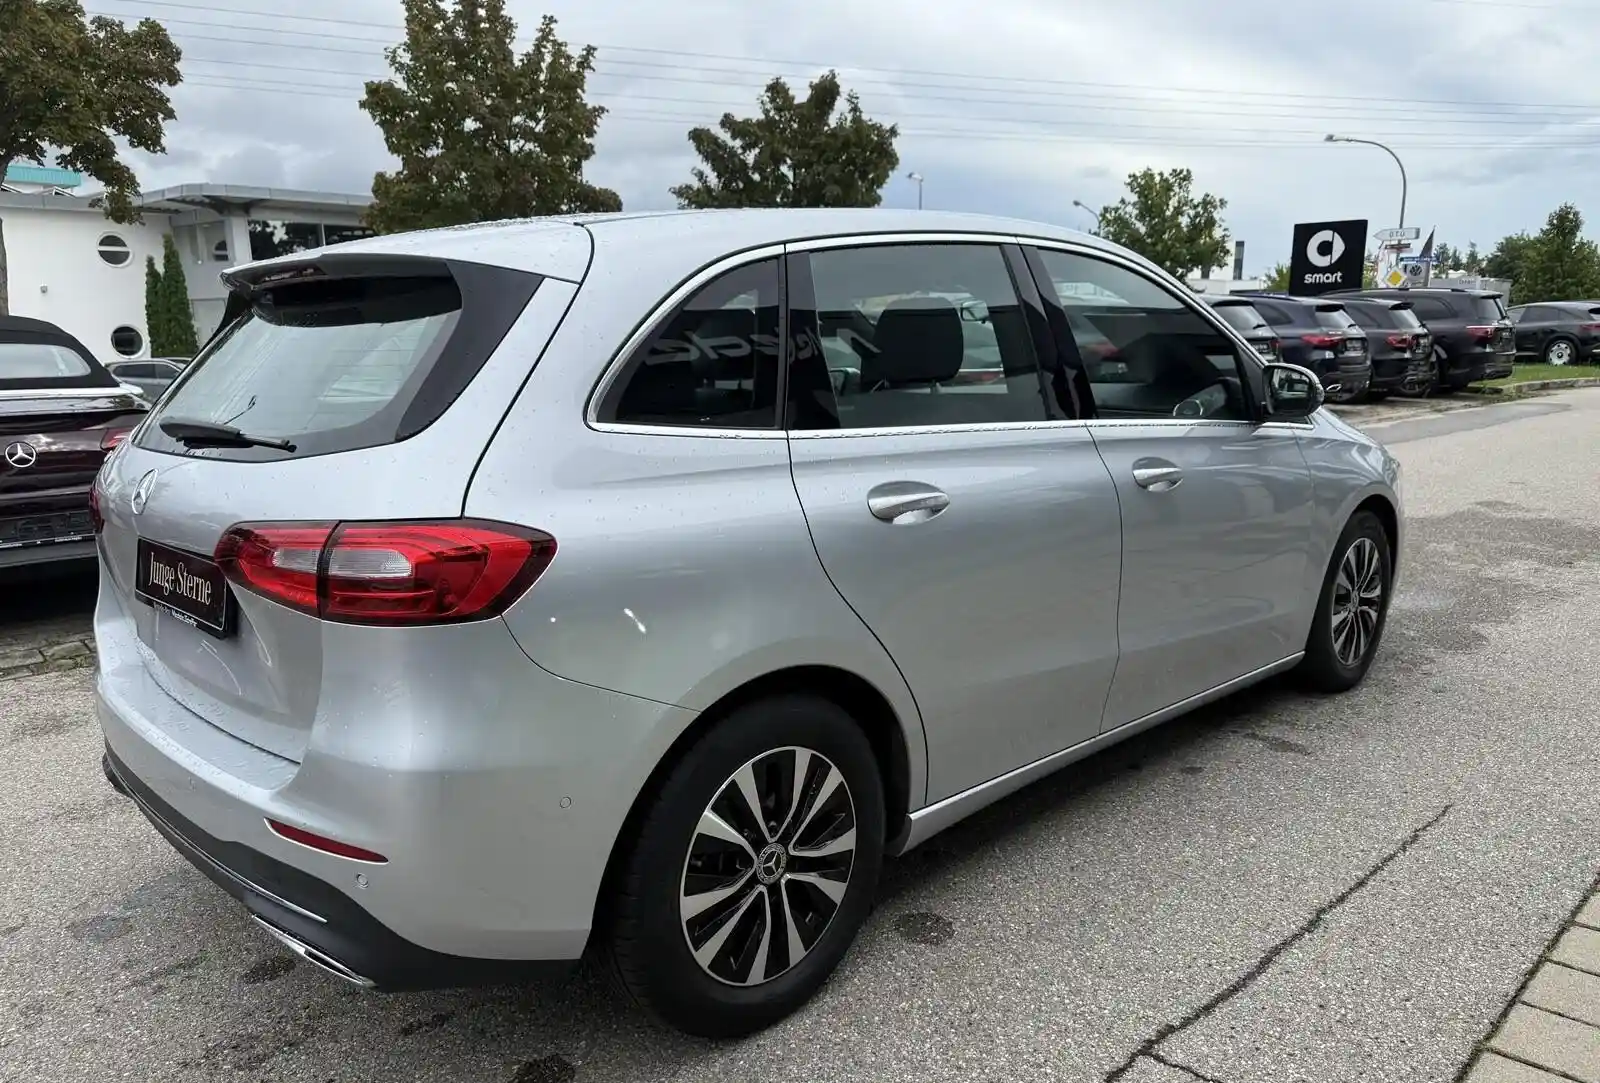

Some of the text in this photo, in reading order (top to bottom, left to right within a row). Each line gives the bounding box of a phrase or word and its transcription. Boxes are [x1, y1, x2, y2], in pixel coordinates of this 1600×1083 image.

[1303, 271, 1343, 284] smart
[148, 552, 212, 606] Junge Sterne
